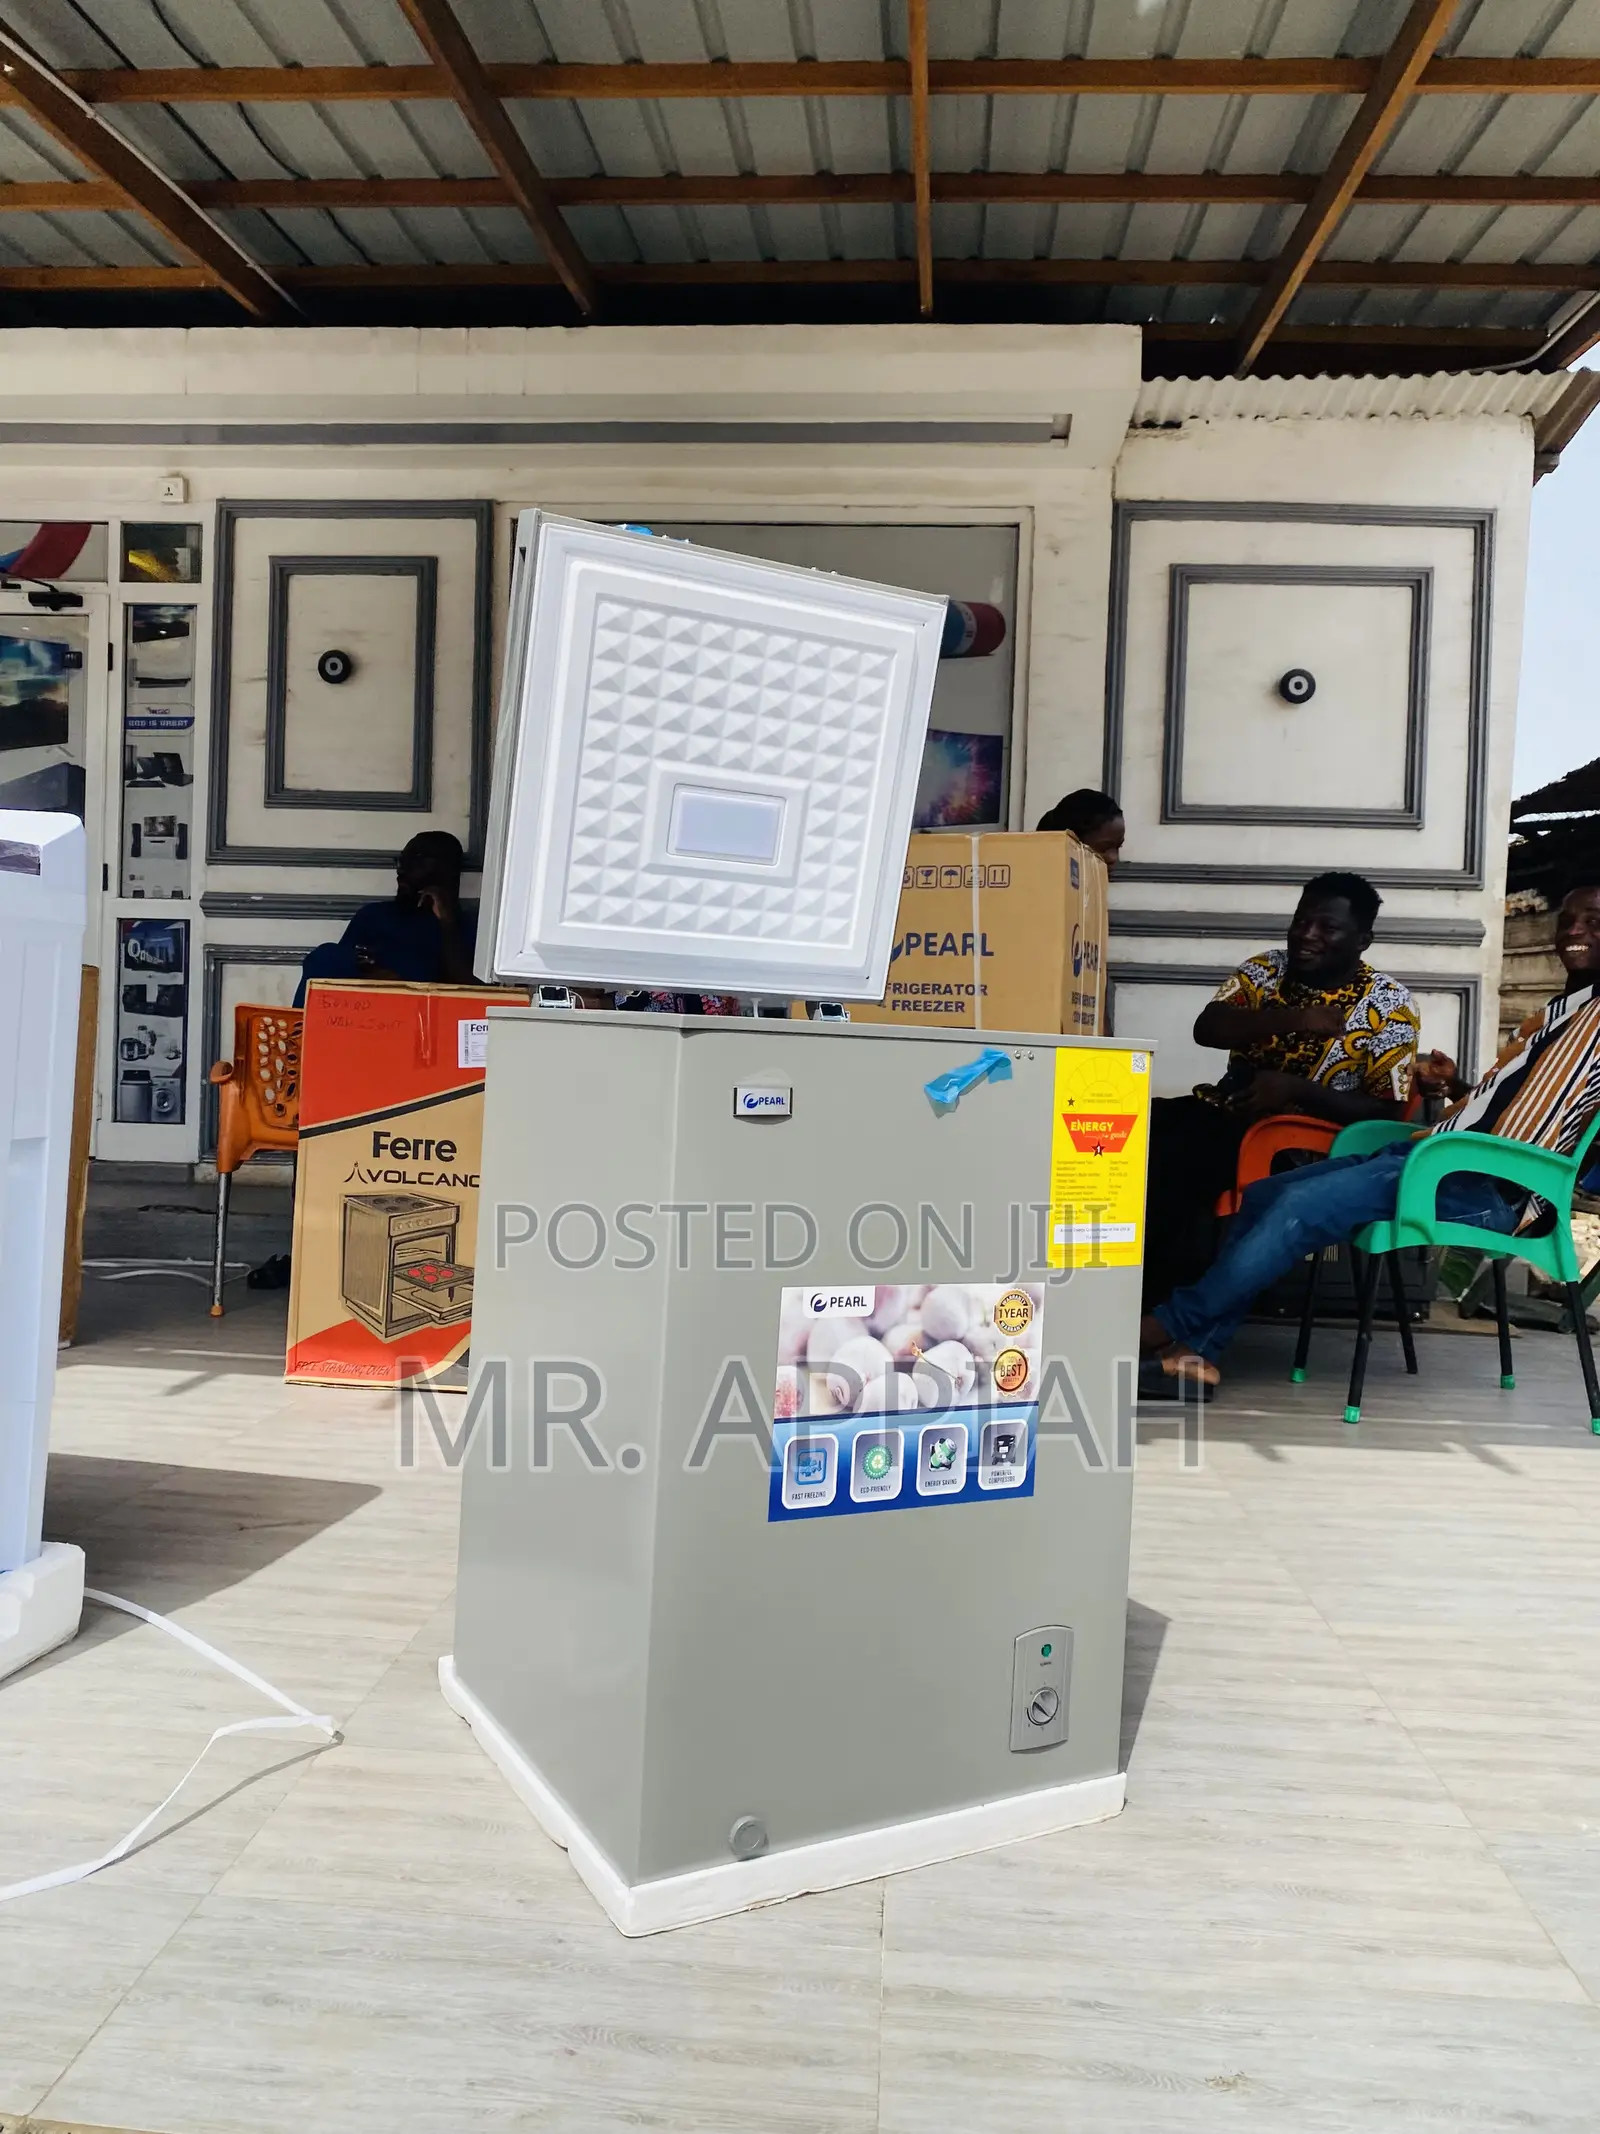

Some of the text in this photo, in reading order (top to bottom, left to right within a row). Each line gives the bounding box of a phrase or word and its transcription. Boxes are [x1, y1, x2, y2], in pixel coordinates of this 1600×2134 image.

[905, 932, 994, 957] PEARL
[891, 999, 965, 1013] FREEZER
[758, 1096, 786, 1106] PEARL
[1070, 1119, 1114, 1136] ENERGY
[372, 1130, 458, 1162] Ferre
[1096, 1145, 1101, 1153] 1
[829, 1295, 867, 1308] PEARL
[366, 1364, 394, 1377] OVEN
[1000, 1363, 1022, 1378] BEST
[942, 1478, 957, 1486] SAVING
[804, 1490, 827, 1499] FREEZING
[860, 1484, 891, 1494] ECO-FRIENDLY
